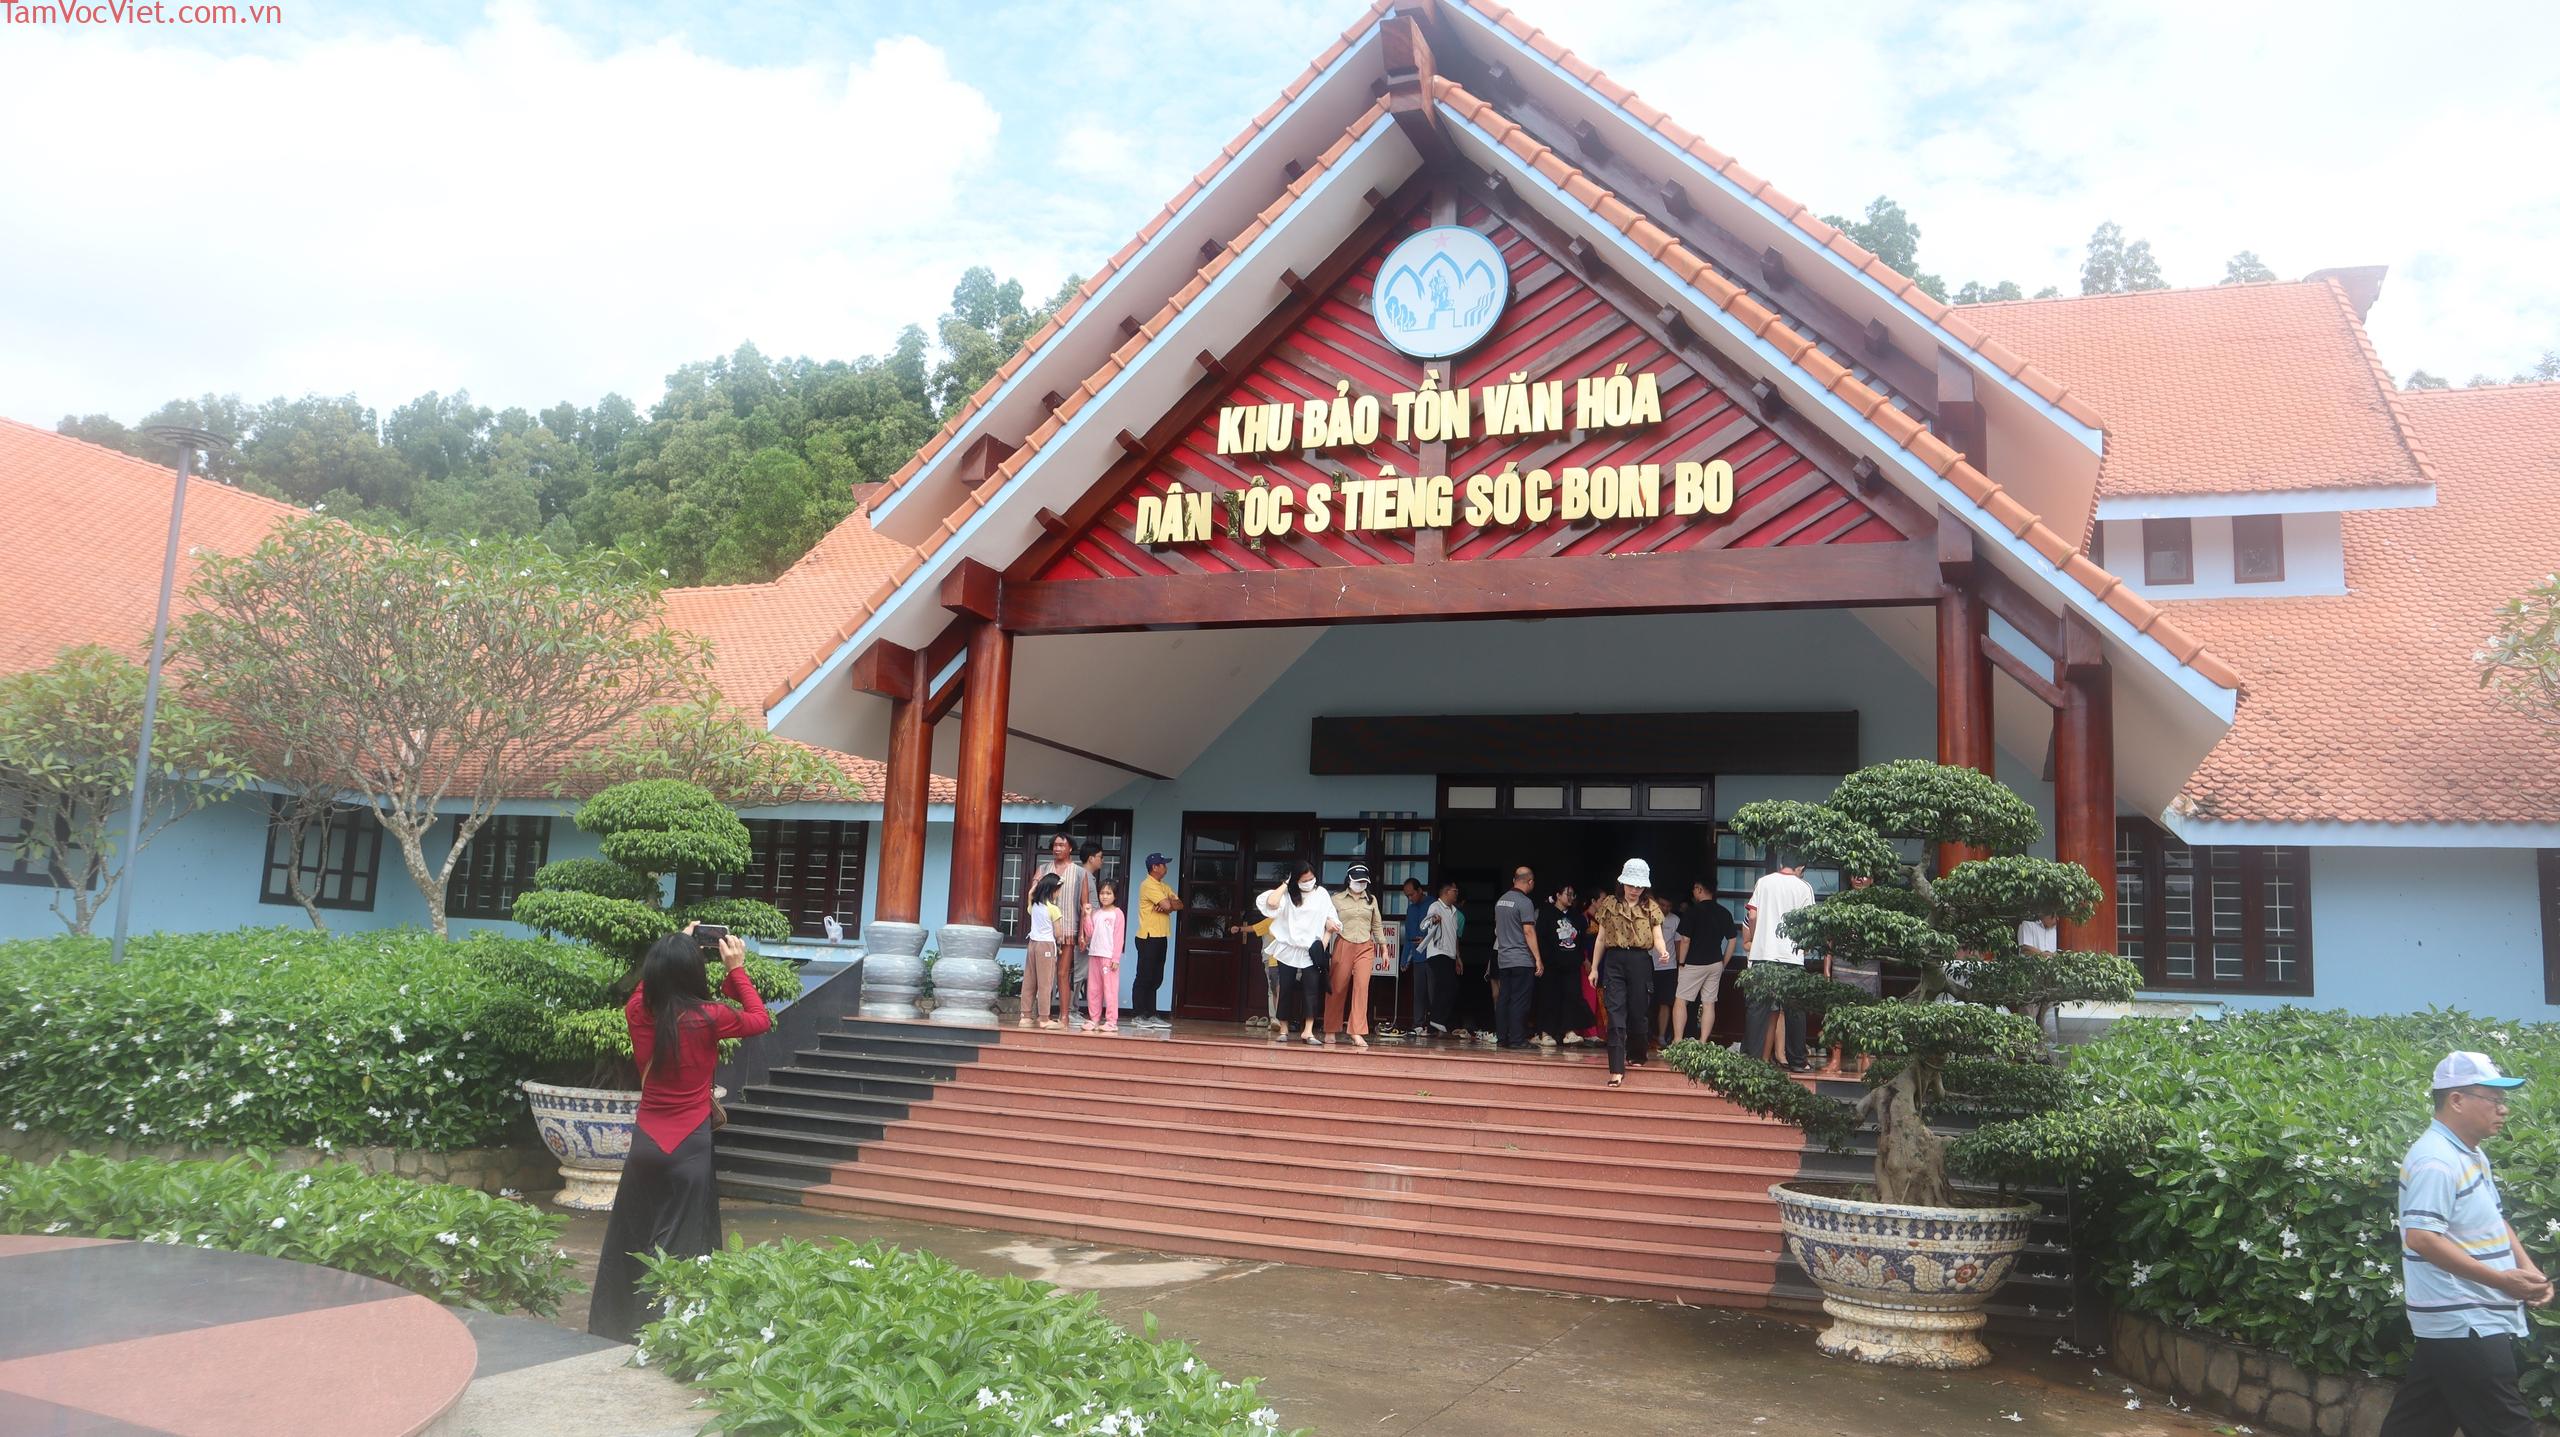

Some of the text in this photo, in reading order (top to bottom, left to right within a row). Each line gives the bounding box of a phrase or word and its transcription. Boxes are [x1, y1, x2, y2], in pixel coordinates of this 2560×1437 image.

[1217, 362, 1662, 454] KHU BẢO TỒN VĂN HÓA
[1135, 482, 1212, 544] DÂN
[1465, 462, 1552, 527] SÓC
[1561, 464, 1660, 519] BOM
[1675, 460, 1733, 515] BO
